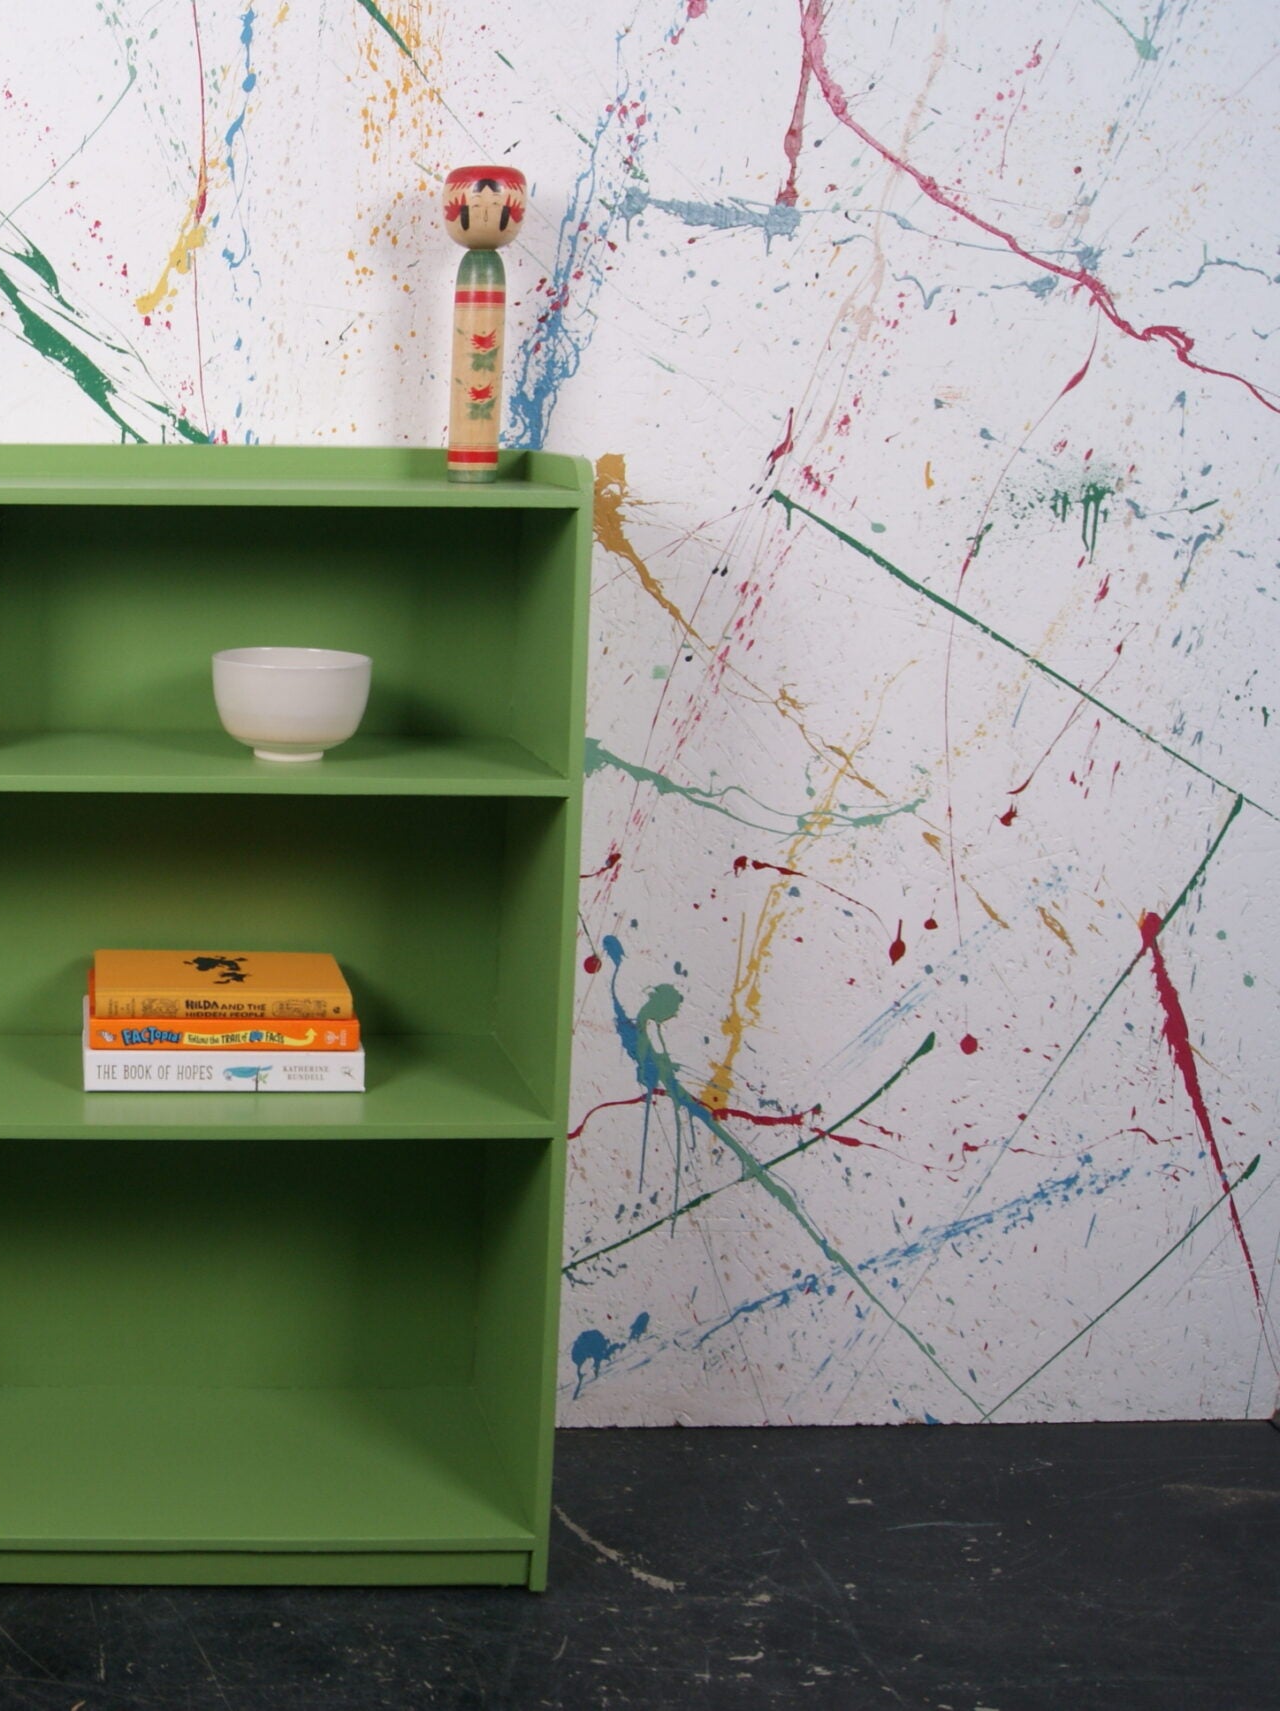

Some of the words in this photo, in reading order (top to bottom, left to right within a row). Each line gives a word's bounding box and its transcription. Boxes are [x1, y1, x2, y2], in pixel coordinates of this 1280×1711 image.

[185, 999, 219, 1010] HILDA
[96, 1064, 117, 1080] THE
[123, 1064, 152, 1080] BOOK
[158, 1064, 171, 1080] OF
[177, 1064, 213, 1080] HOPES
